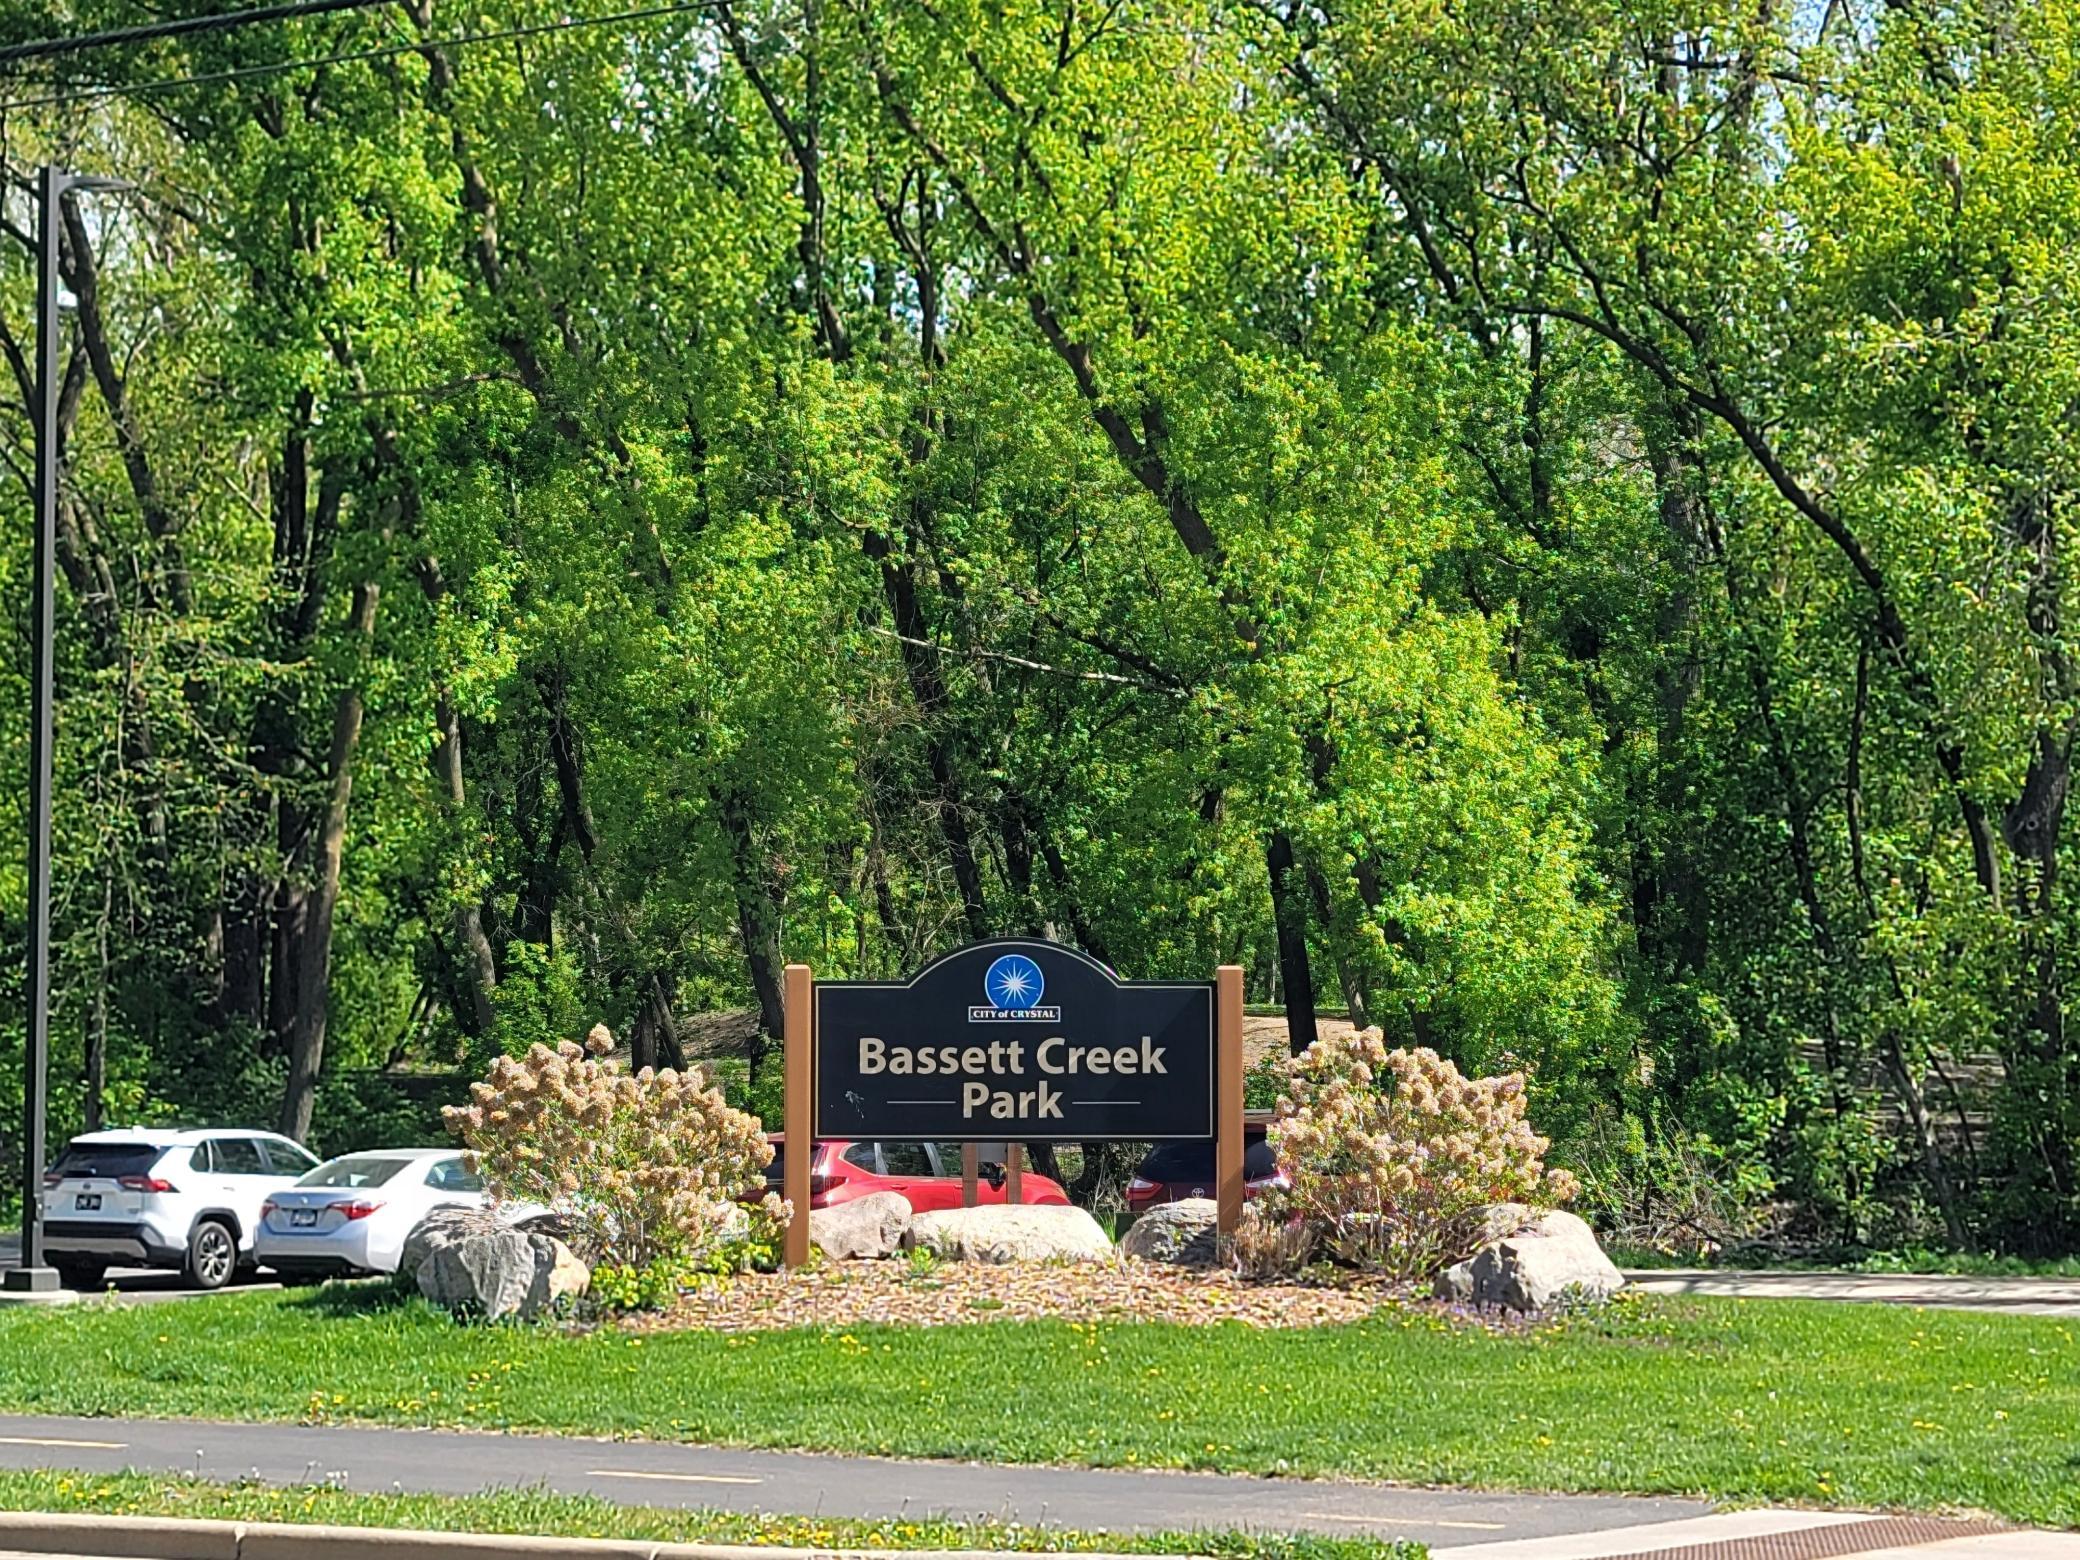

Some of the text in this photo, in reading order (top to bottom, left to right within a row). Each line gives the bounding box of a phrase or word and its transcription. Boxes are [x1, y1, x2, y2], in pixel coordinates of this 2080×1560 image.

[972, 1009, 1056, 1019] CITY of CRYSTAL
[859, 1036, 1169, 1075] Bassett Creek
[962, 1080, 1065, 1119] Park
